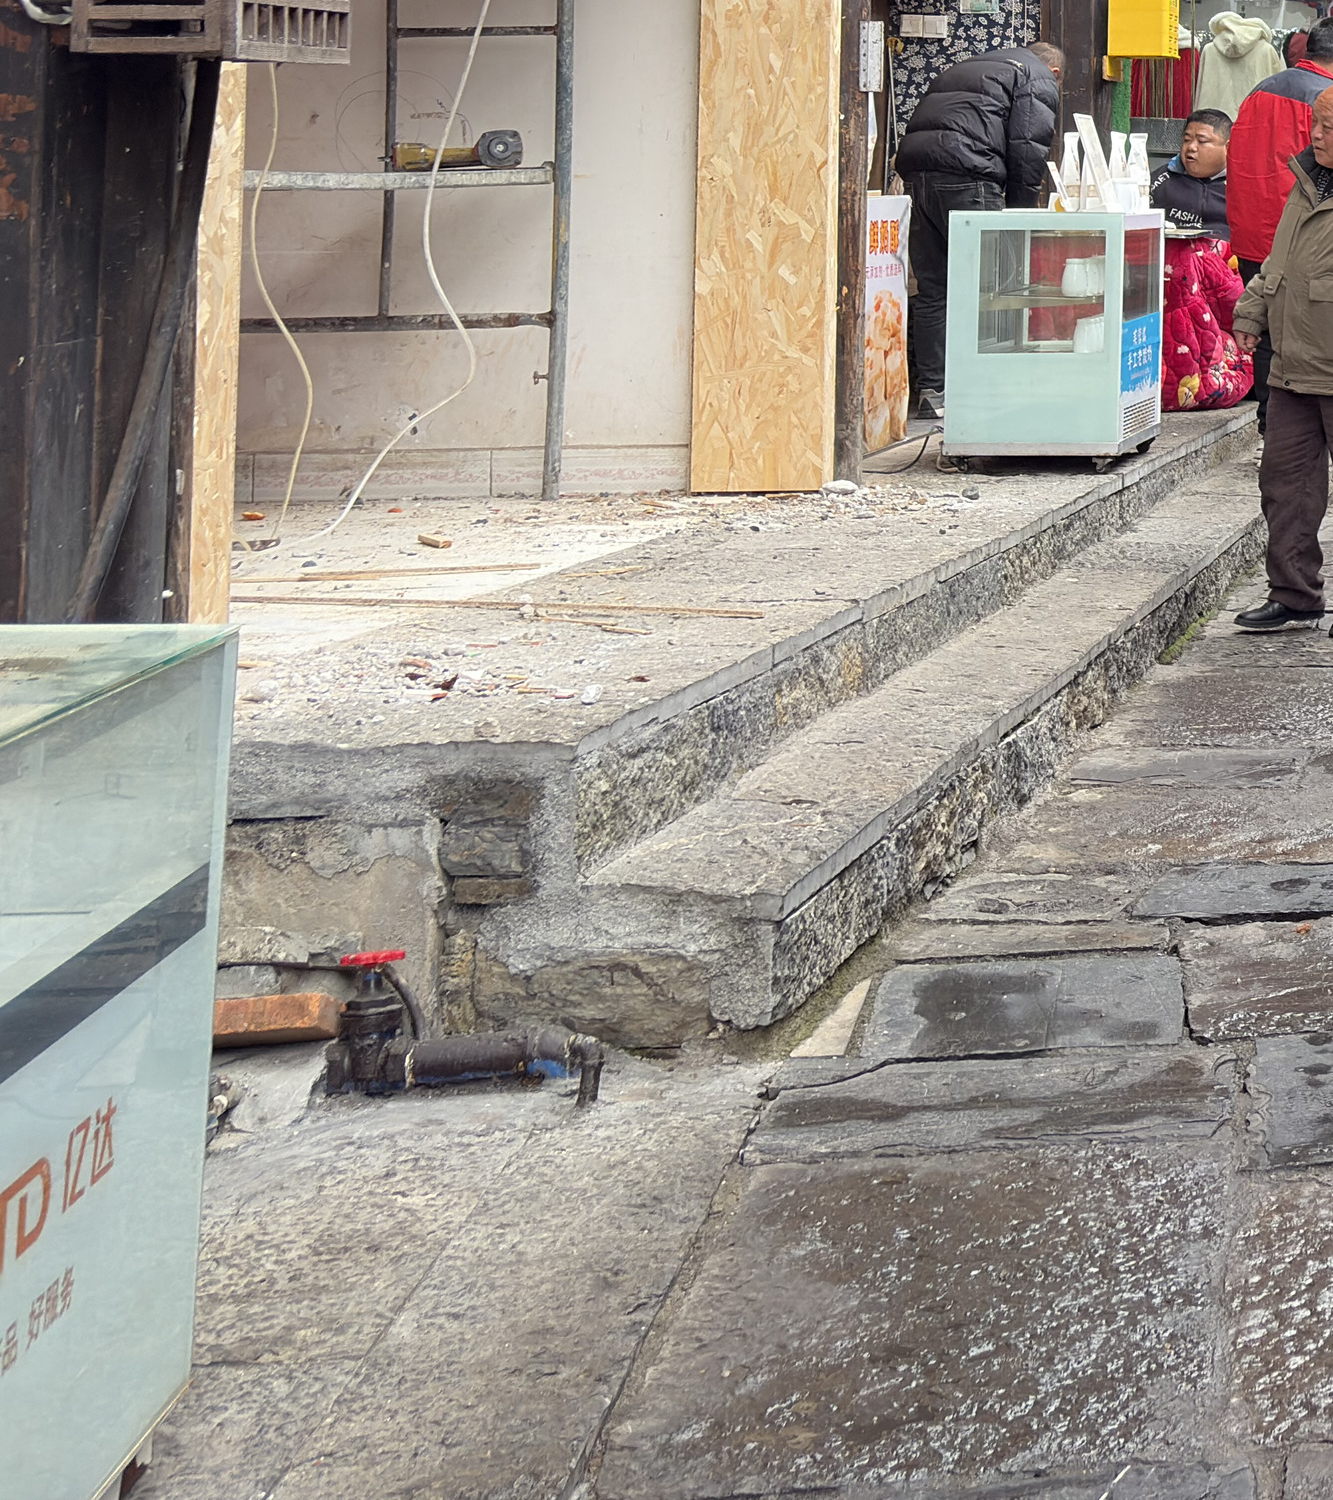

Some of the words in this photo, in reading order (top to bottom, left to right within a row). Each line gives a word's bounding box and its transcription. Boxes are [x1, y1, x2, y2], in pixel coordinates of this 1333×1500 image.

[61, 1095, 118, 1215] 亿达
[25, 1263, 75, 1352] 好服务
